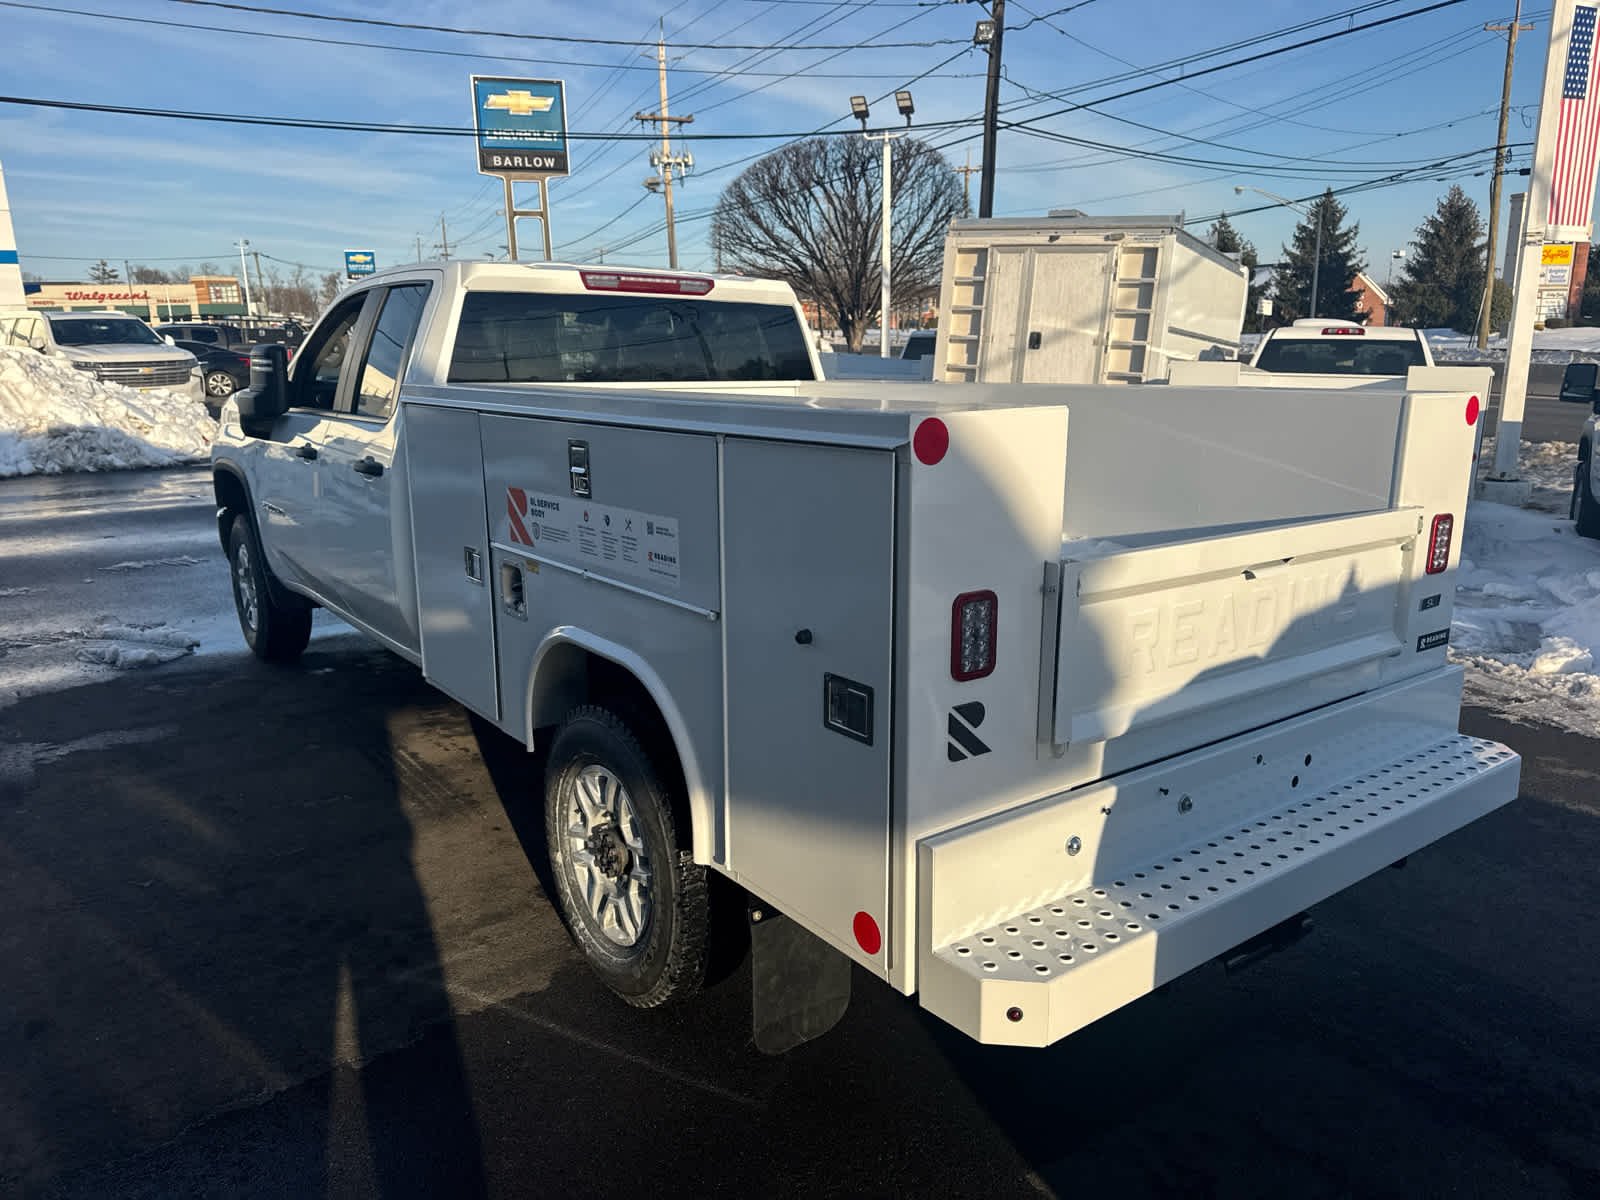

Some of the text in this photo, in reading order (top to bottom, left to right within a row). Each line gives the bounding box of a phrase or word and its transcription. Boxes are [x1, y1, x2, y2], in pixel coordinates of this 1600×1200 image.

[493, 156, 555, 168] BARLOW
[64, 290, 151, 303] Walgreens
[537, 498, 560, 512] SERVICE
[531, 508, 545, 519] BODY
